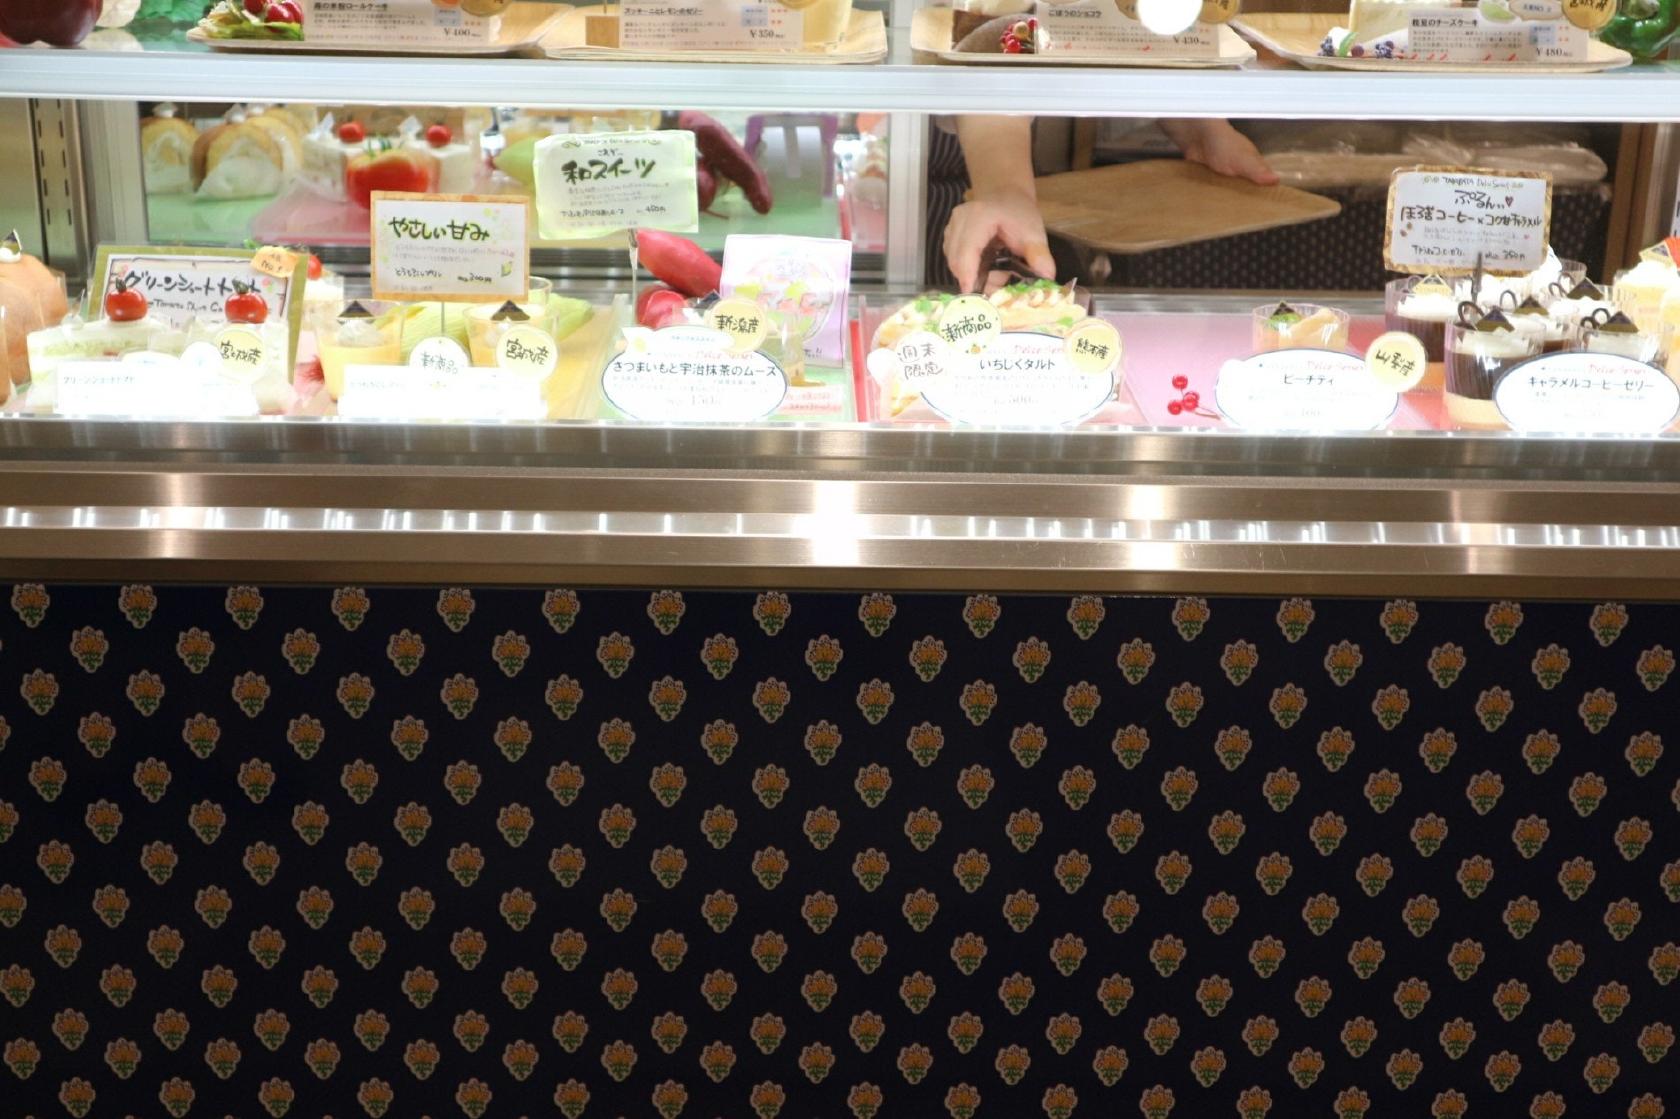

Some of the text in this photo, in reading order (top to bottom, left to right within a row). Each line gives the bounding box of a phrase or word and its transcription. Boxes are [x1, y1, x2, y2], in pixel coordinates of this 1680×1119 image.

[560, 157, 656, 185] 和スイーツ
[388, 216, 490, 241] やさしい甘み
[941, 313, 992, 342] 新商品
[612, 361, 777, 377] さつまいもと宇治抹茶のムース
[979, 358, 1056, 371] いちじくタルト
[1283, 373, 1334, 386] ピーチティ
[1528, 376, 1655, 392] キャラメルコーヒーゼリー
